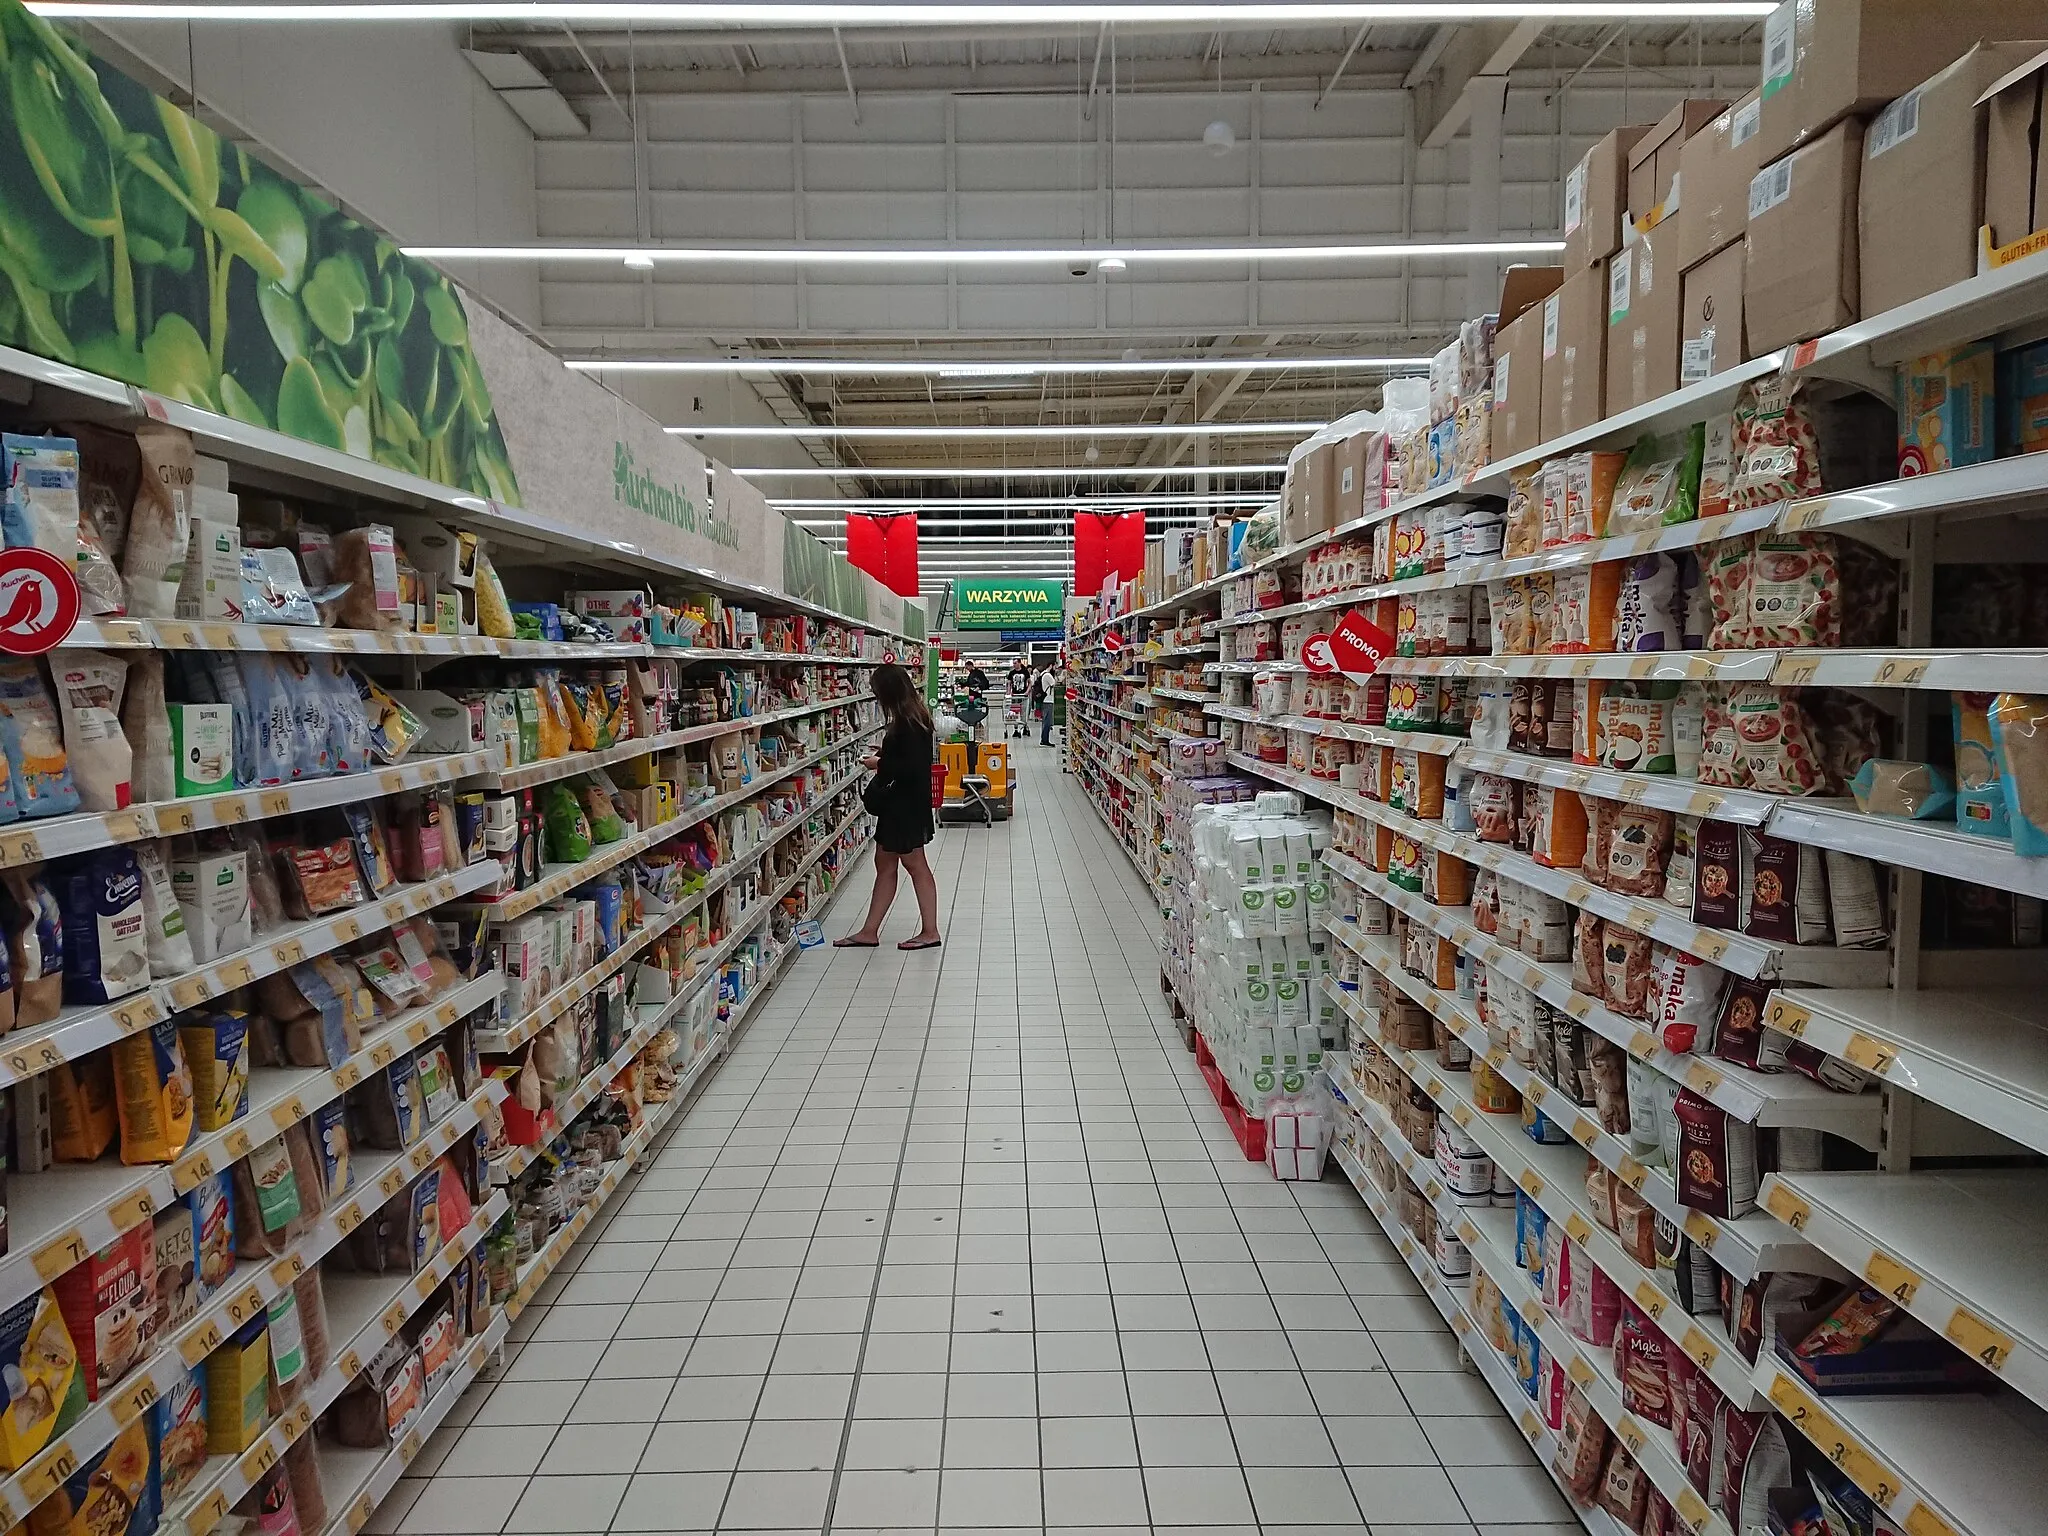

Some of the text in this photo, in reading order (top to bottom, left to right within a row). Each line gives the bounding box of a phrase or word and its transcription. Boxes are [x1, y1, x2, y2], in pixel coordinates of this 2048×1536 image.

[1, 573, 31, 590] Auchan
[966, 590, 1048, 603] WARZYWA
[1340, 628, 1380, 661] PROMO
[1791, 667, 1811, 683] 17
[1647, 703, 1665, 756] mąka
[992, 759, 998, 768] 1
[1664, 965, 1686, 1021] mąka
[1787, 1019, 1803, 1036] 4
[1874, 1053, 1889, 1070] 7
[1679, 1098, 1702, 1109] PRIMO
[138, 1200, 152, 1217] 9
[1789, 1211, 1801, 1228] 6
[66, 1244, 81, 1263] 7
[156, 1227, 192, 1262] KETO
[108, 1269, 136, 1306] FLOUR
[1893, 1282, 1910, 1302] 4
[199, 1329, 219, 1351] 14
[1631, 1338, 1662, 1355] Mąka
[1979, 1344, 2000, 1367] 4
[132, 1388, 153, 1410] 10
[1792, 1406, 1806, 1421] 2
[45, 1457, 72, 1485] 10
[255, 1452, 274, 1472] 11
